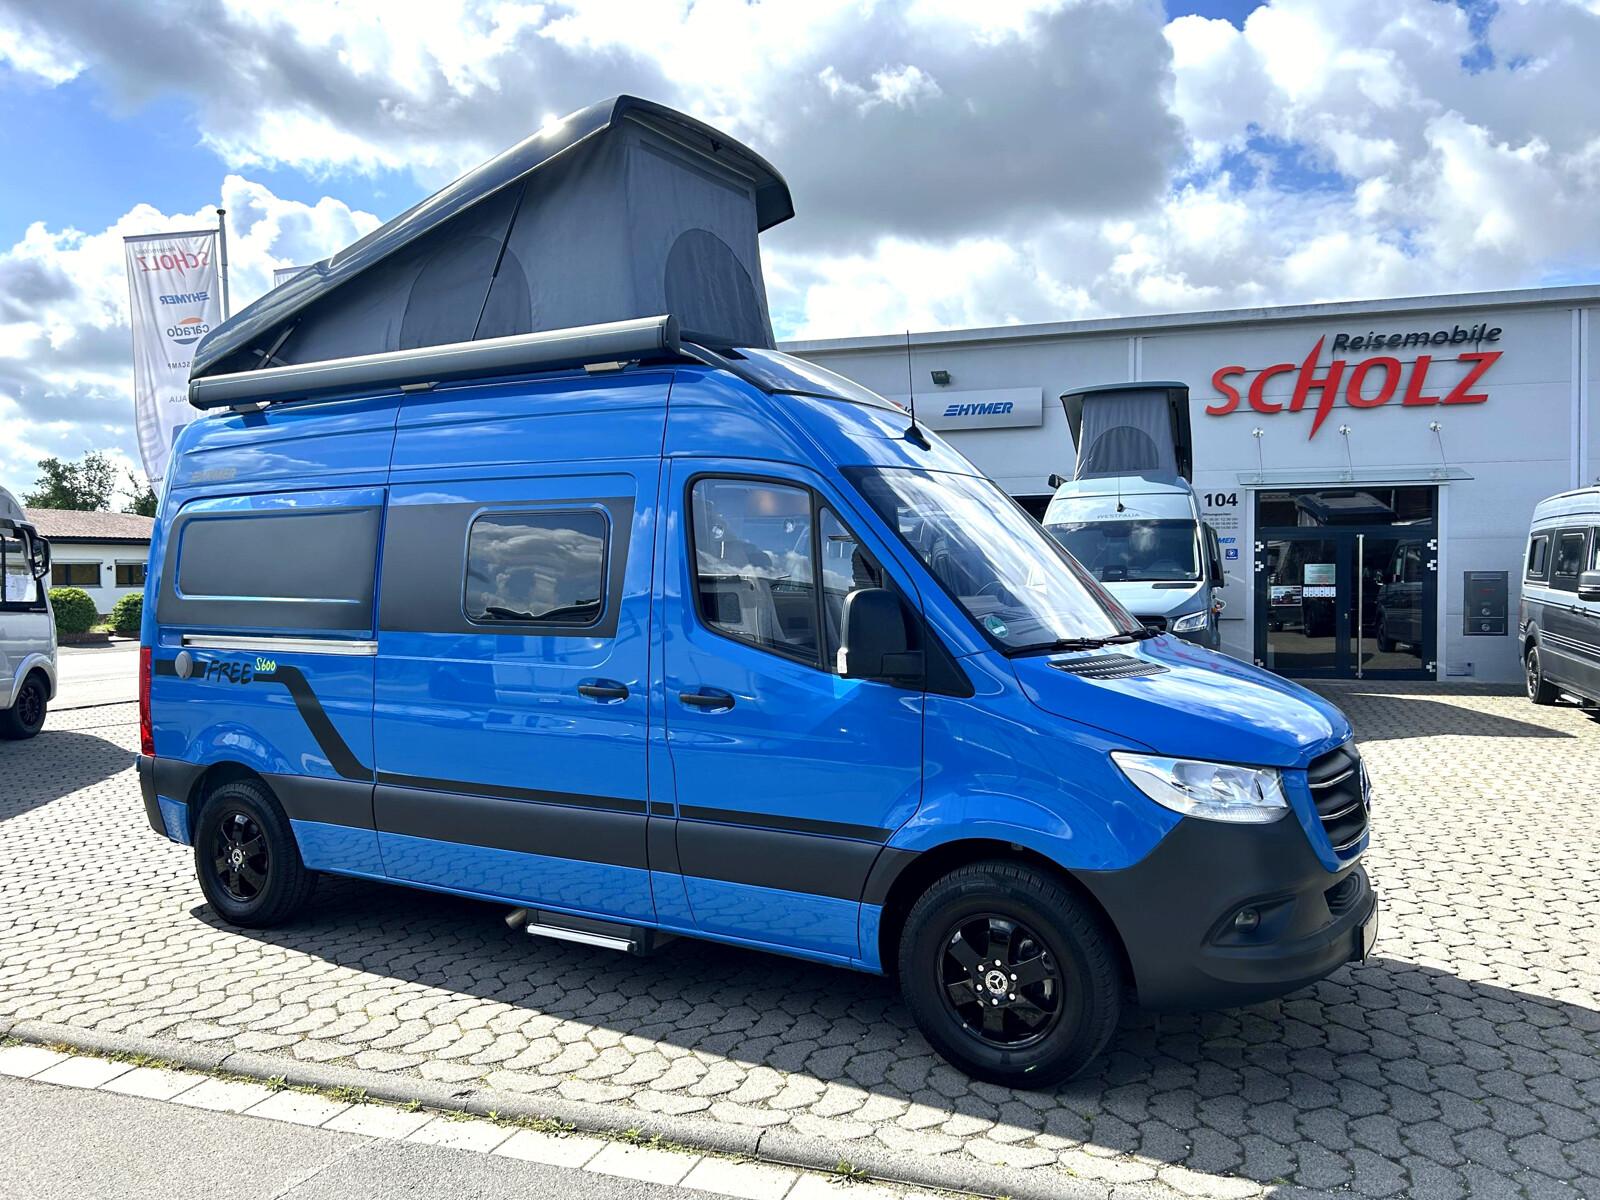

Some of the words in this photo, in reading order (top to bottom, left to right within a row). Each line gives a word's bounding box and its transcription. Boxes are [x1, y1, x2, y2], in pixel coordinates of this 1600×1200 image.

[1332, 323, 1503, 352] Reisemobile
[1205, 334, 1504, 441] SCHOLZ
[956, 401, 1014, 416] HYMER
[1204, 493, 1238, 507] 104
[206, 659, 252, 684] FREE
[254, 657, 276, 672] S600
